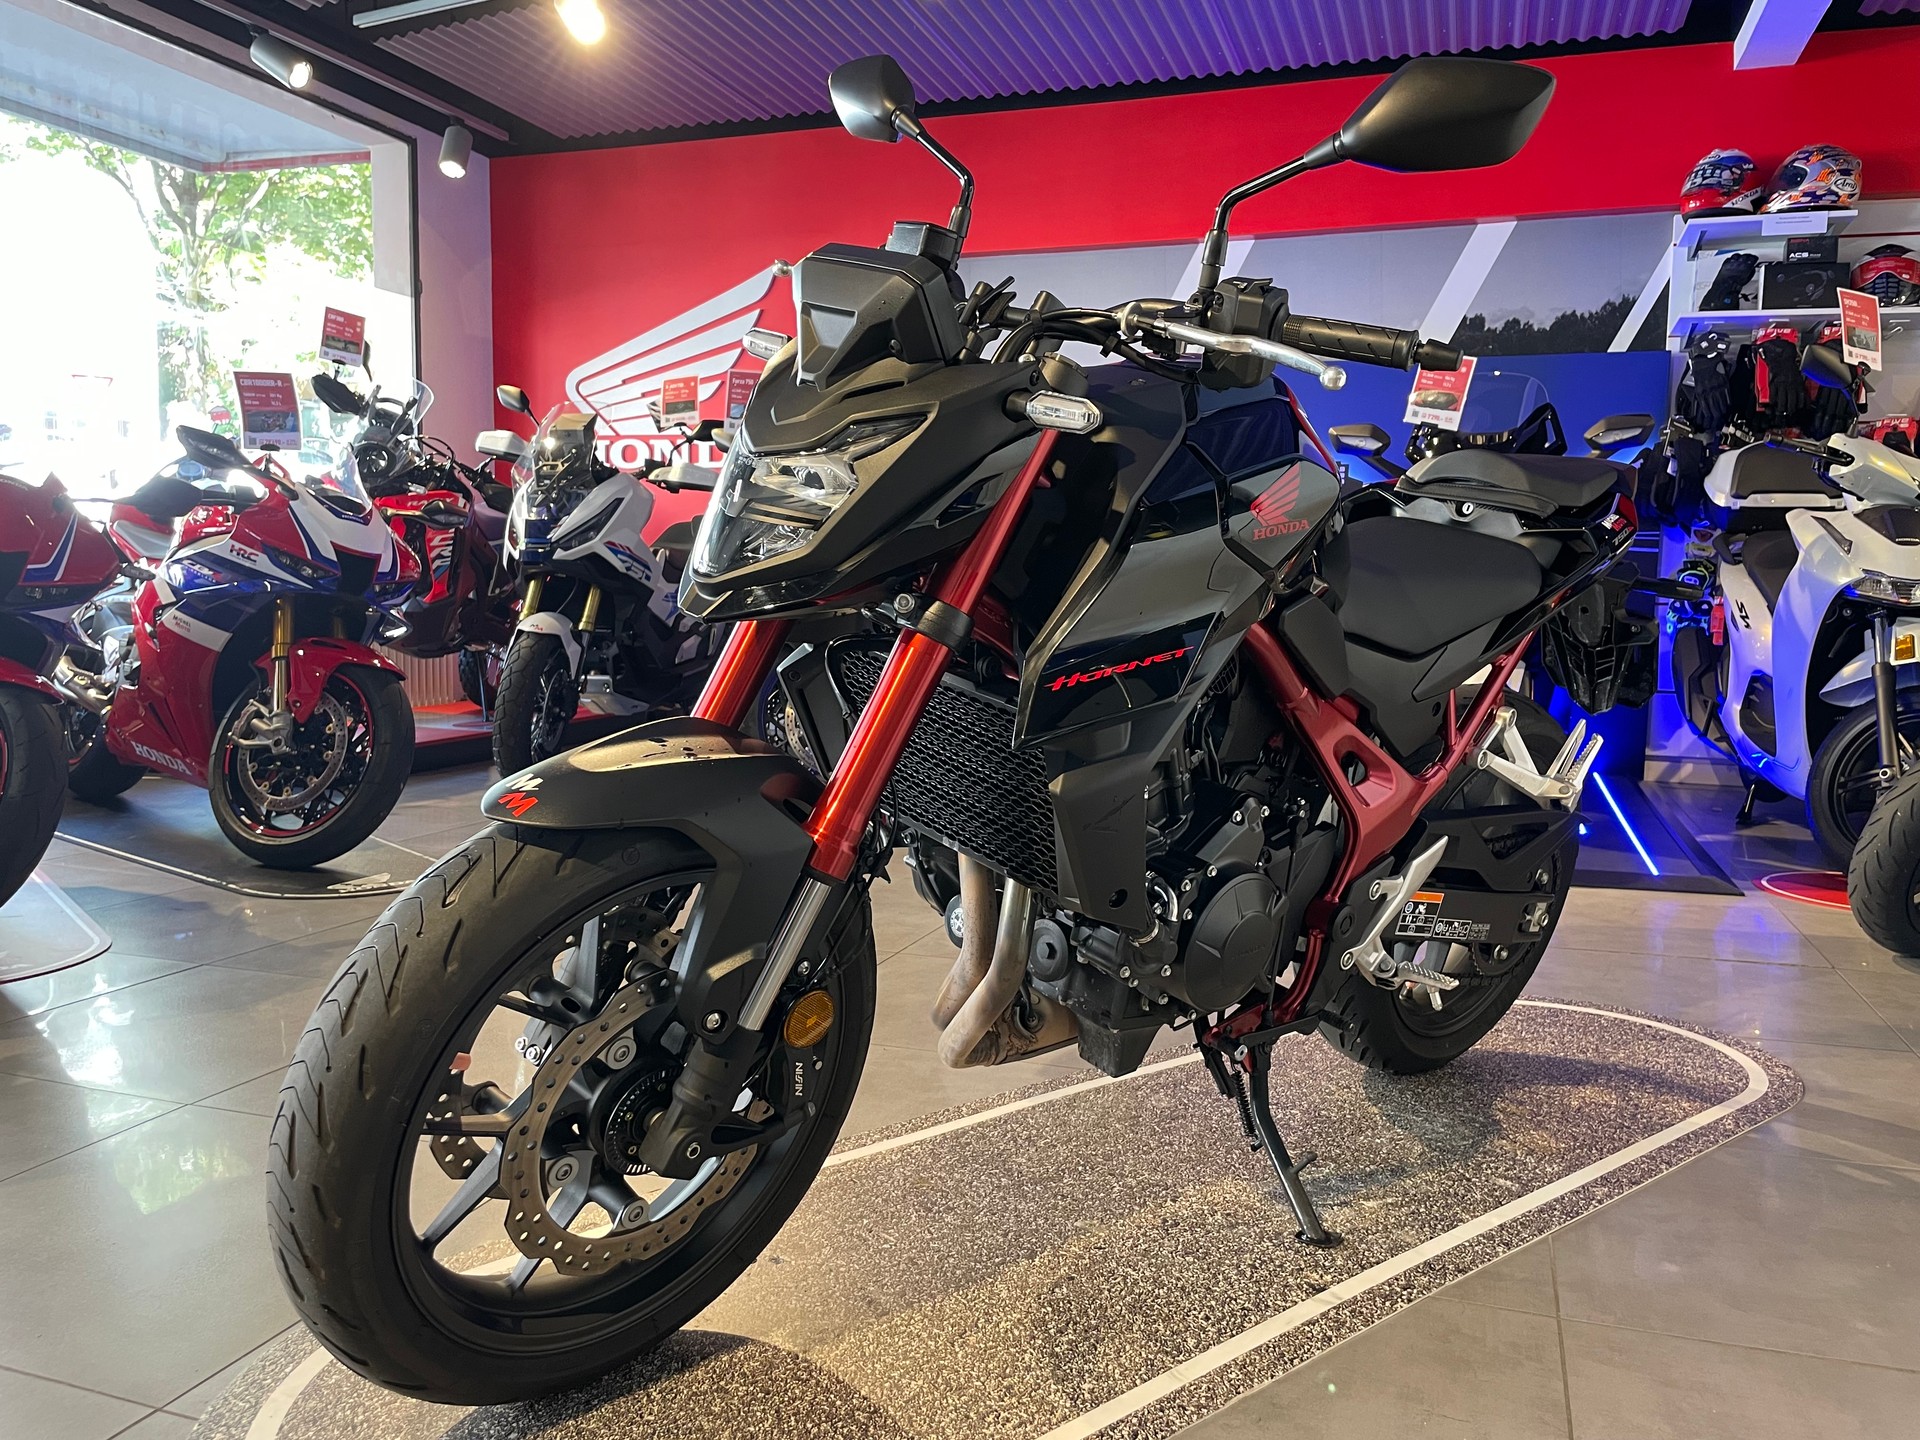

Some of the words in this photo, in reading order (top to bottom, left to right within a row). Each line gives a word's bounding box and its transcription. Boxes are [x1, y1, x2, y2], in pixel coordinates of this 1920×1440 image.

[1730, 189, 1760, 206] HONDA
[1252, 517, 1310, 541] HONDA
[229, 543, 260, 563] HRC
[1044, 646, 1195, 692] HORNET
[130, 740, 193, 776] HONDA
